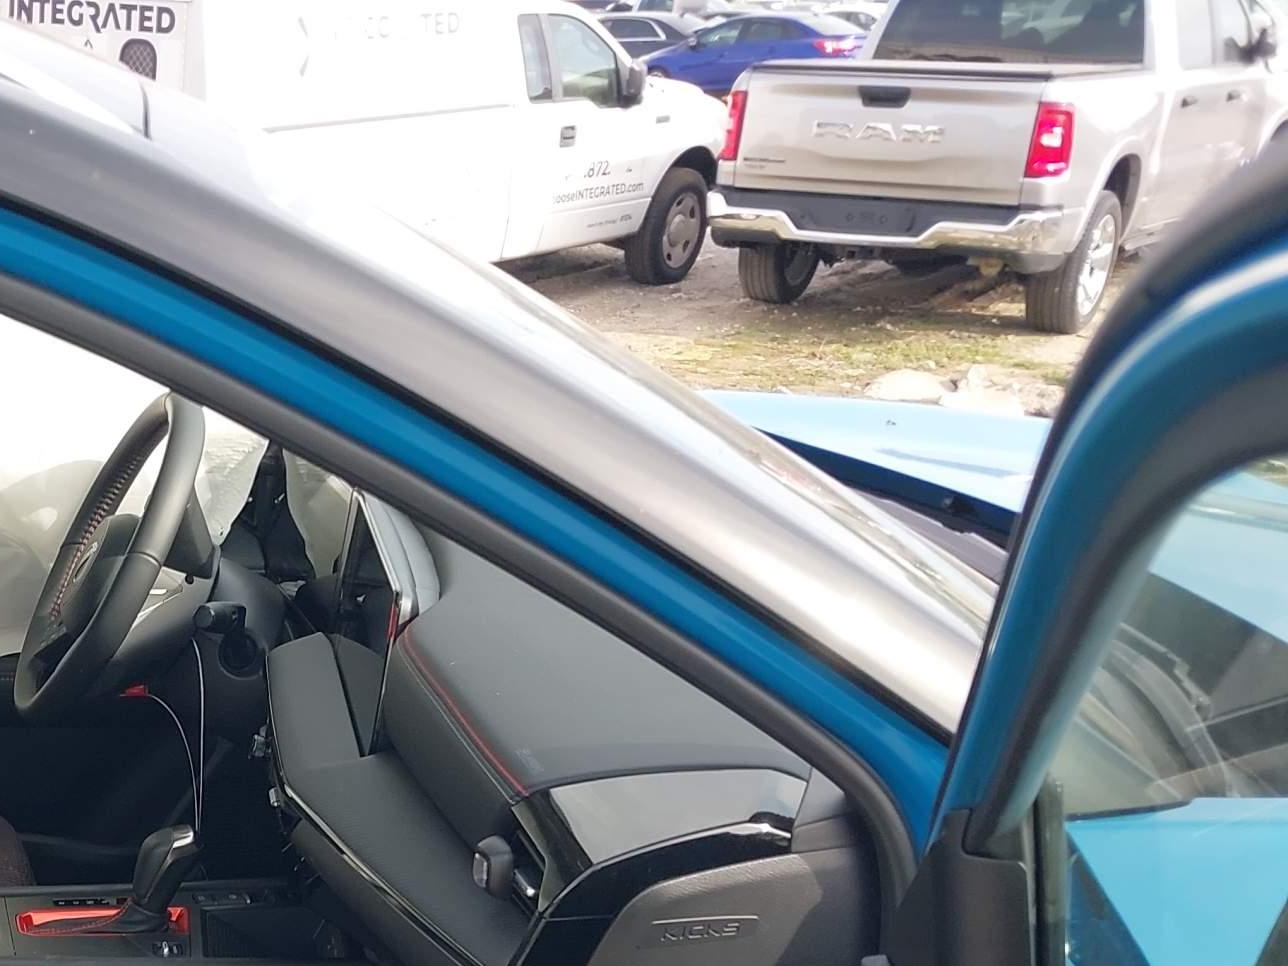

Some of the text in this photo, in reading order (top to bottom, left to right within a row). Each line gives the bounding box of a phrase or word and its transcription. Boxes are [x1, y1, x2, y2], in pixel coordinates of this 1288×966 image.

[8, 0, 176, 34] INTEGRATED
[812, 120, 944, 144] RAM
[660, 922, 741, 942] KICKS
